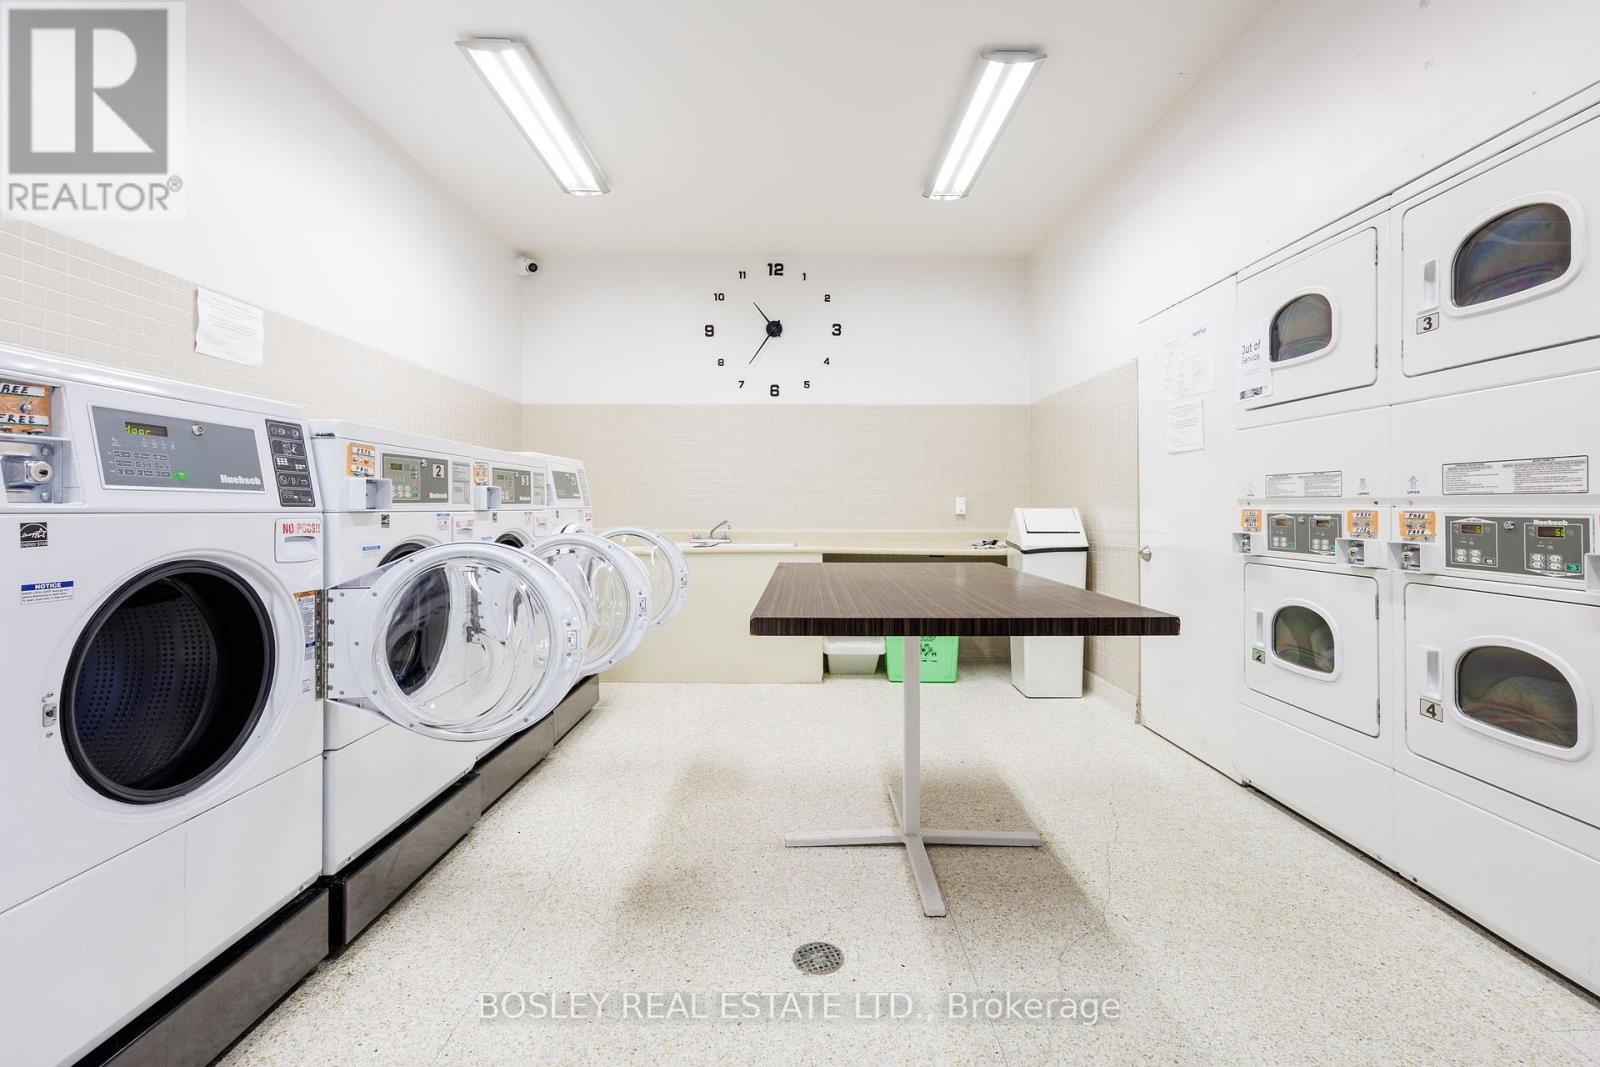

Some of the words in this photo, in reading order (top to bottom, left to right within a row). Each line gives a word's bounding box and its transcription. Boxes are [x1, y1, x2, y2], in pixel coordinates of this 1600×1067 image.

[738, 271, 747, 279] 11
[767, 263, 784, 276] 12
[713, 293, 725, 301] 10
[824, 294, 831, 302] 2
[1422, 316, 1433, 331] 3
[704, 324, 714, 337] 9
[832, 323, 842, 336] 3
[1241, 343, 1252, 355] Out
[1253, 339, 1261, 350] of
[717, 358, 725, 366] 8
[823, 357, 830, 365] 4
[1, 384, 29, 393] REE
[738, 380, 745, 388] 7
[803, 380, 810, 389] 5
[769, 384, 780, 397] 6
[436, 465, 442, 477] 2
[220, 474, 261, 485] Huebsch
[283, 523, 295, 534] NO
[1426, 703, 1437, 718] 4
